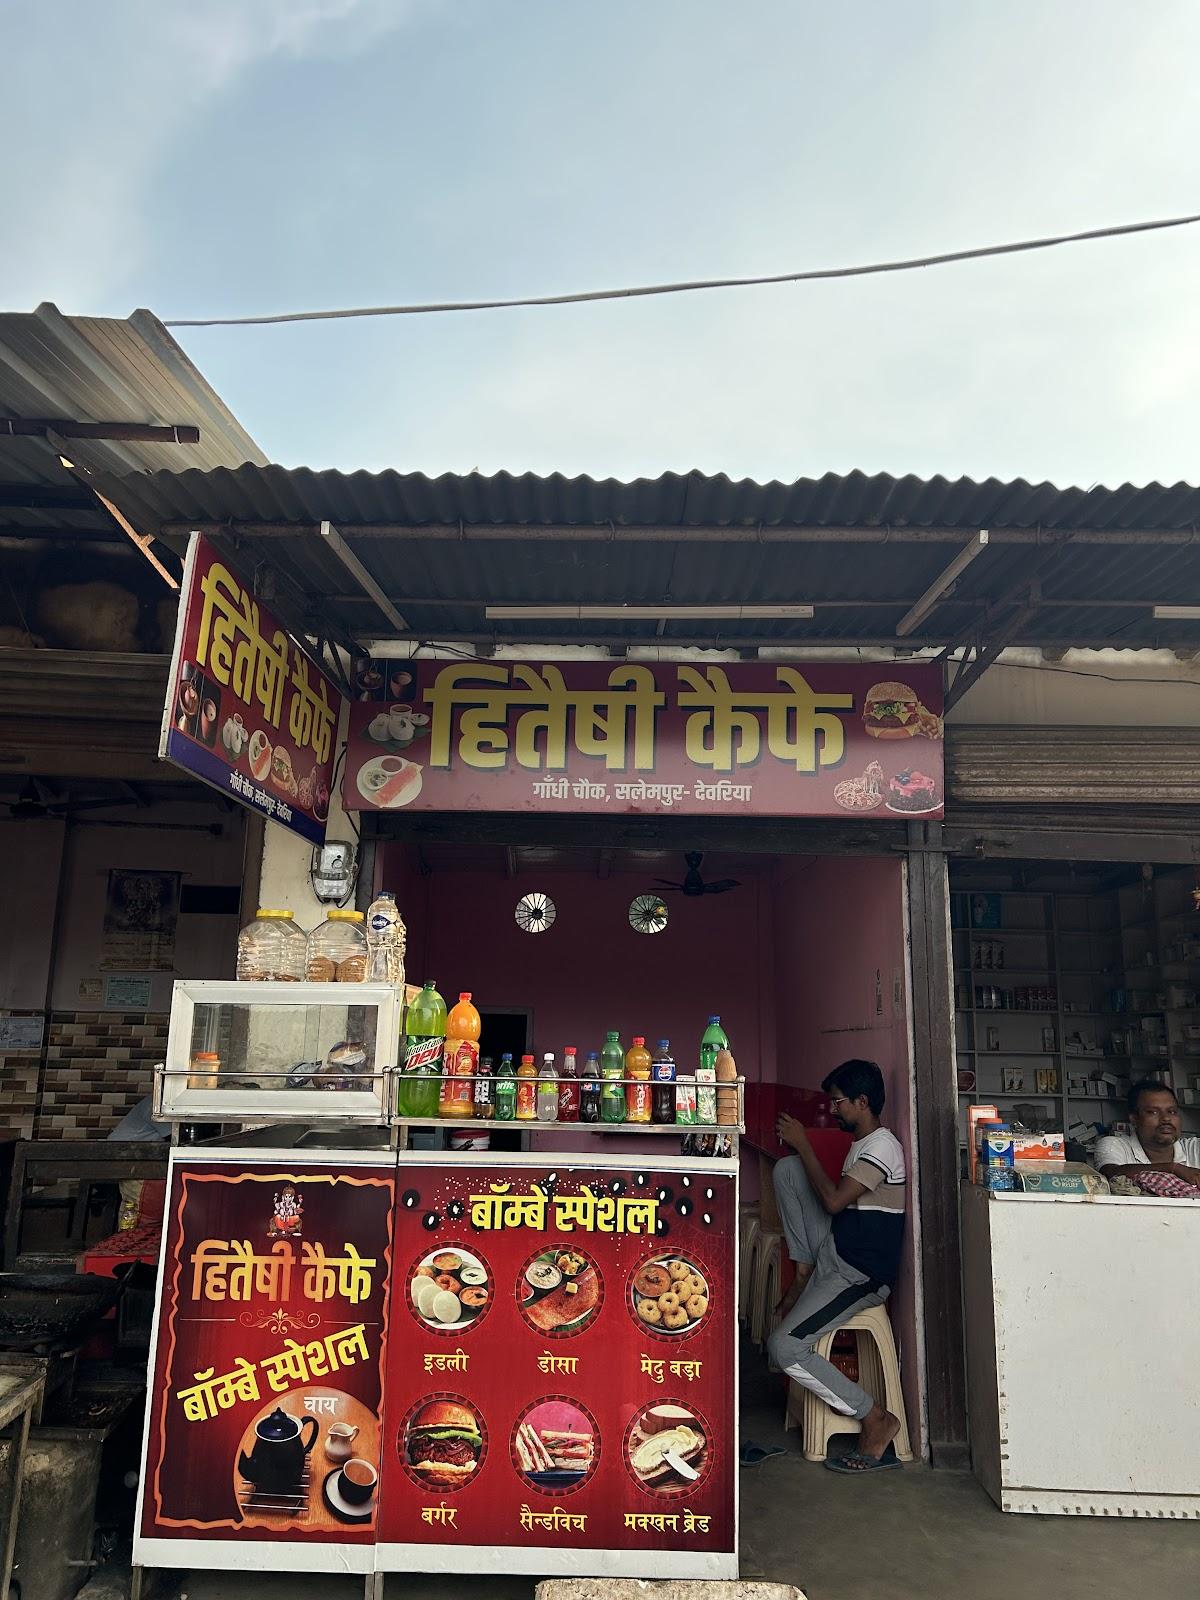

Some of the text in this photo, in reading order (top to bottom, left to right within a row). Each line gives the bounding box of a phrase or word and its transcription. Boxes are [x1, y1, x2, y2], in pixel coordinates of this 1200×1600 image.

[196, 562, 336, 765] हितैषी कैफे
[423, 663, 853, 772] हितैषी कैफे
[572, 778, 610, 802] चौक,
[694, 780, 752, 801] देवरिया
[469, 1184, 660, 1234] बॉम्बे स्पेशल
[190, 1239, 376, 1304] हितैषी कैफे
[177, 1324, 370, 1422] बॉम्बे स्पेशल
[424, 1348, 470, 1376] इडली
[537, 1350, 579, 1376] डोसा
[640, 1353, 703, 1384] मेदु बड़ा
[304, 1396, 338, 1415] चाय
[421, 1501, 458, 1530] बर्गर
[520, 1503, 588, 1533] सैन्डविच
[624, 1507, 712, 1533] मक्खन ब्रेड
